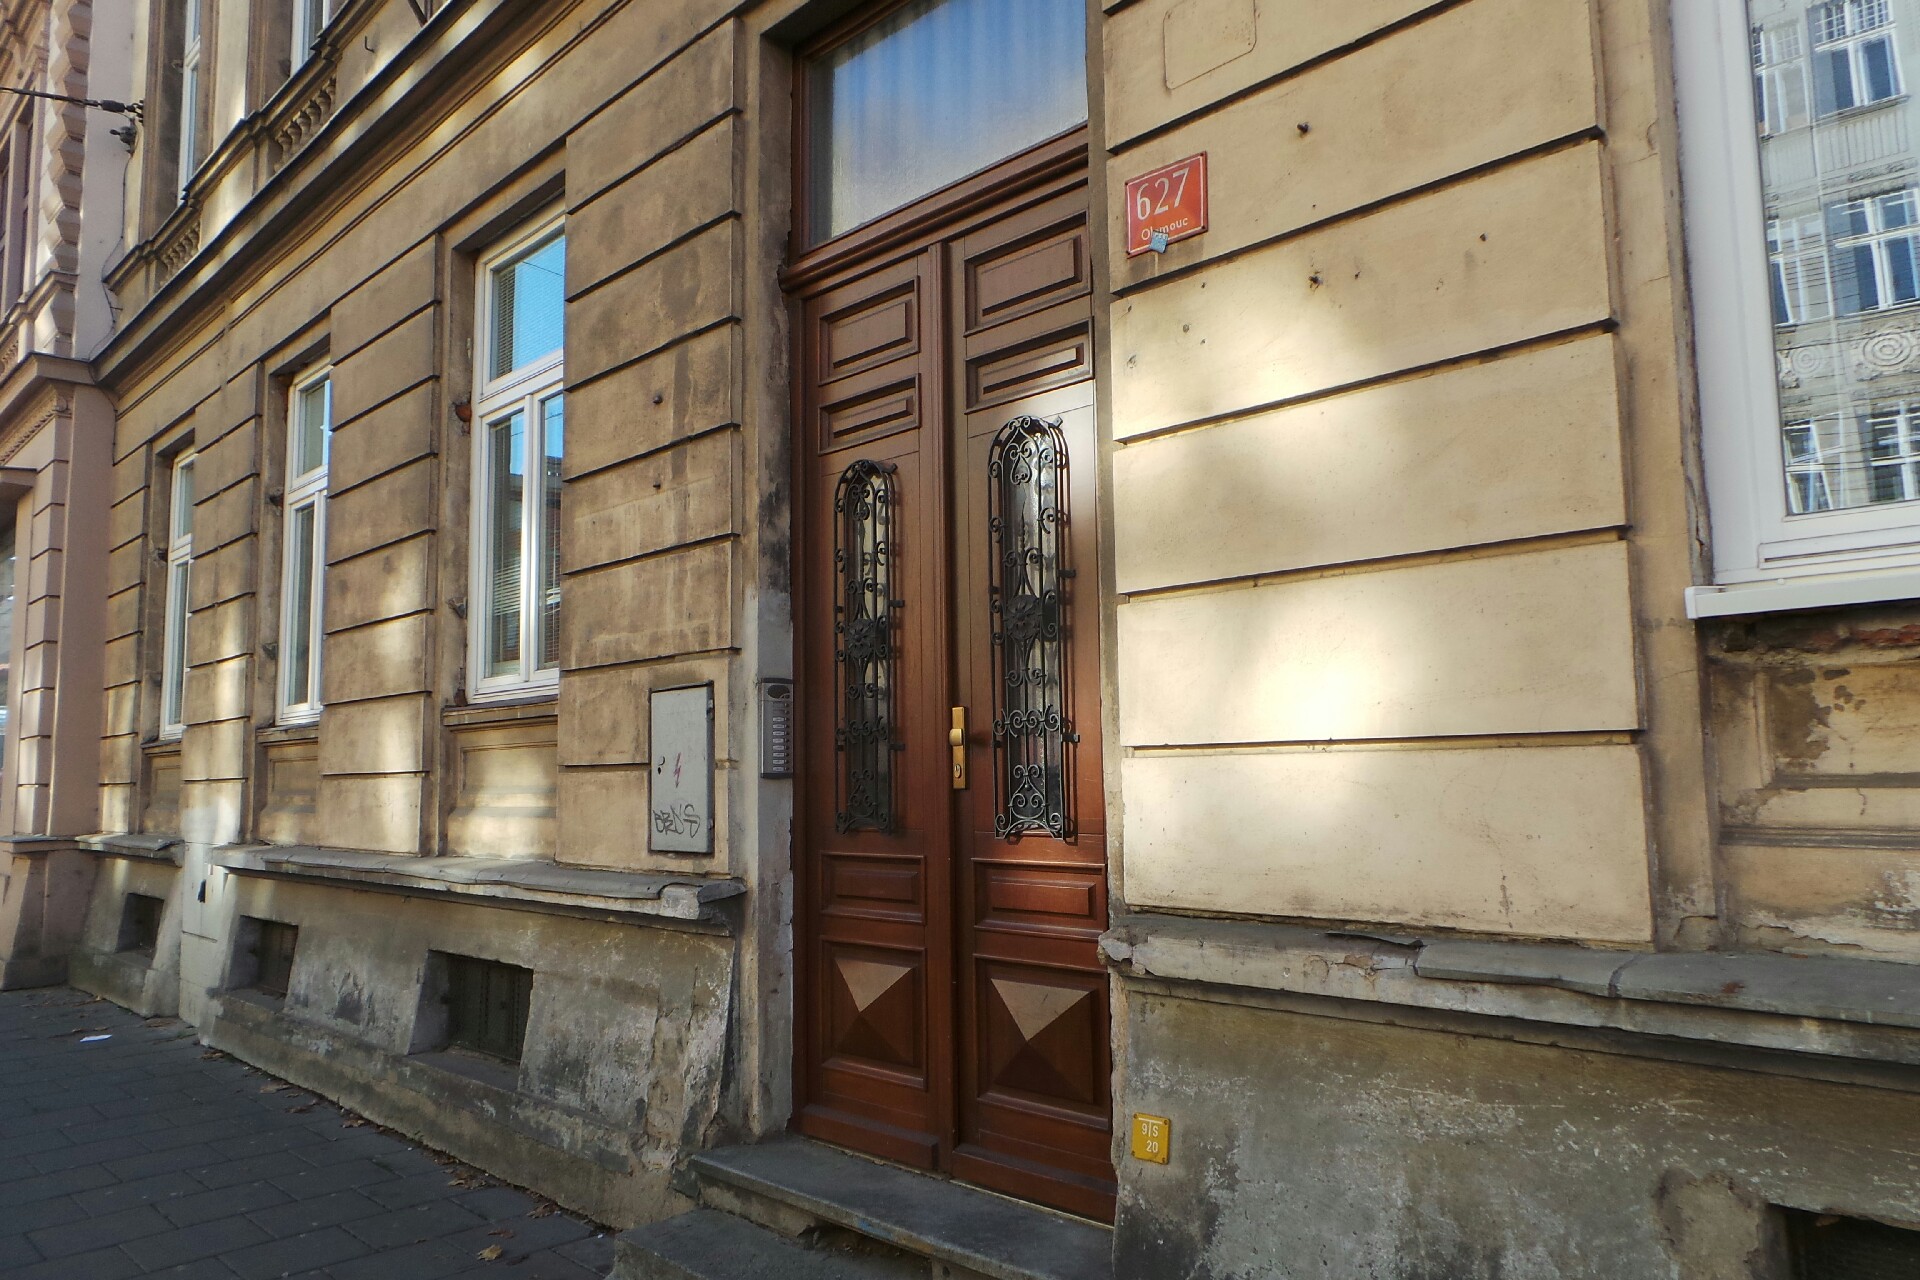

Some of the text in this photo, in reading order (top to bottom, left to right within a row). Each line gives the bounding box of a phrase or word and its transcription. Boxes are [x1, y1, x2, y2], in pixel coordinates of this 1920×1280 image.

[1136, 167, 1189, 220] 627
[1141, 217, 1189, 240] Olmouc
[1146, 1140, 1159, 1153] 20
